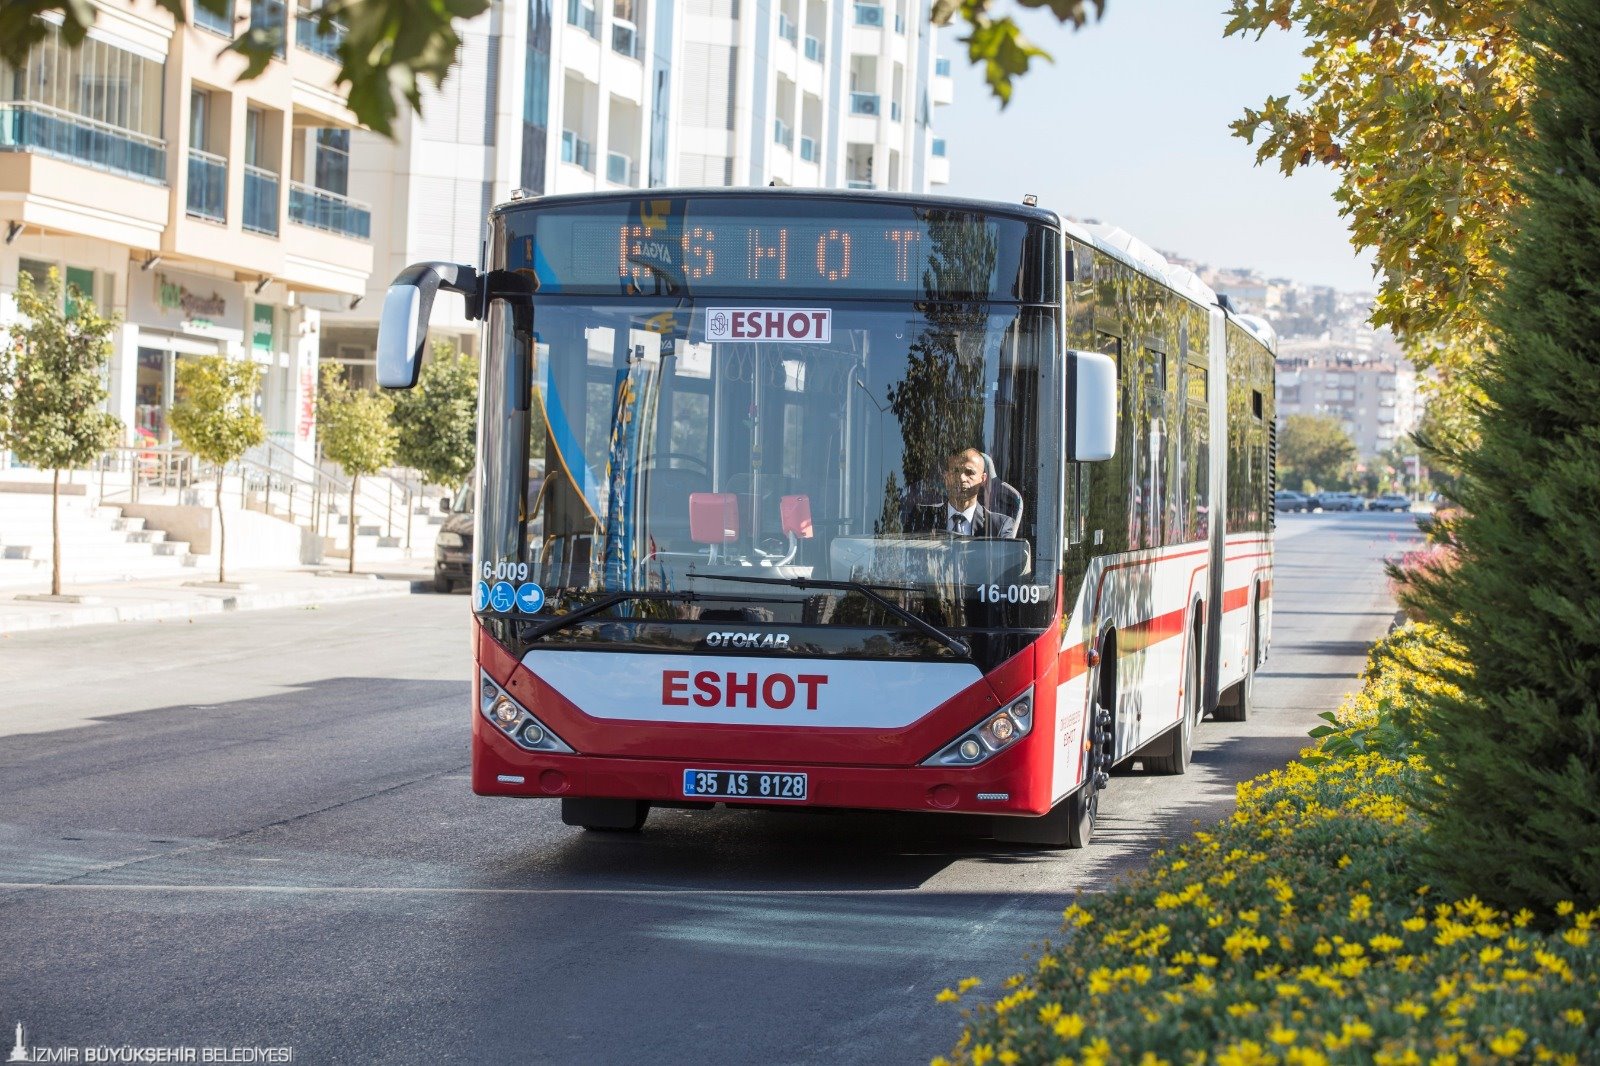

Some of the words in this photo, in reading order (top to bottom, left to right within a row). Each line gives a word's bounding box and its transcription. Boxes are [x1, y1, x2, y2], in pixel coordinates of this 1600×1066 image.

[731, 311, 827, 339] ESHOT
[977, 583, 1040, 605] 16-009
[705, 631, 791, 650] OTOKAR
[661, 669, 829, 711] ESHOT
[696, 772, 718, 794] 35
[726, 774, 749, 795] AS
[760, 775, 804, 797] 8128
